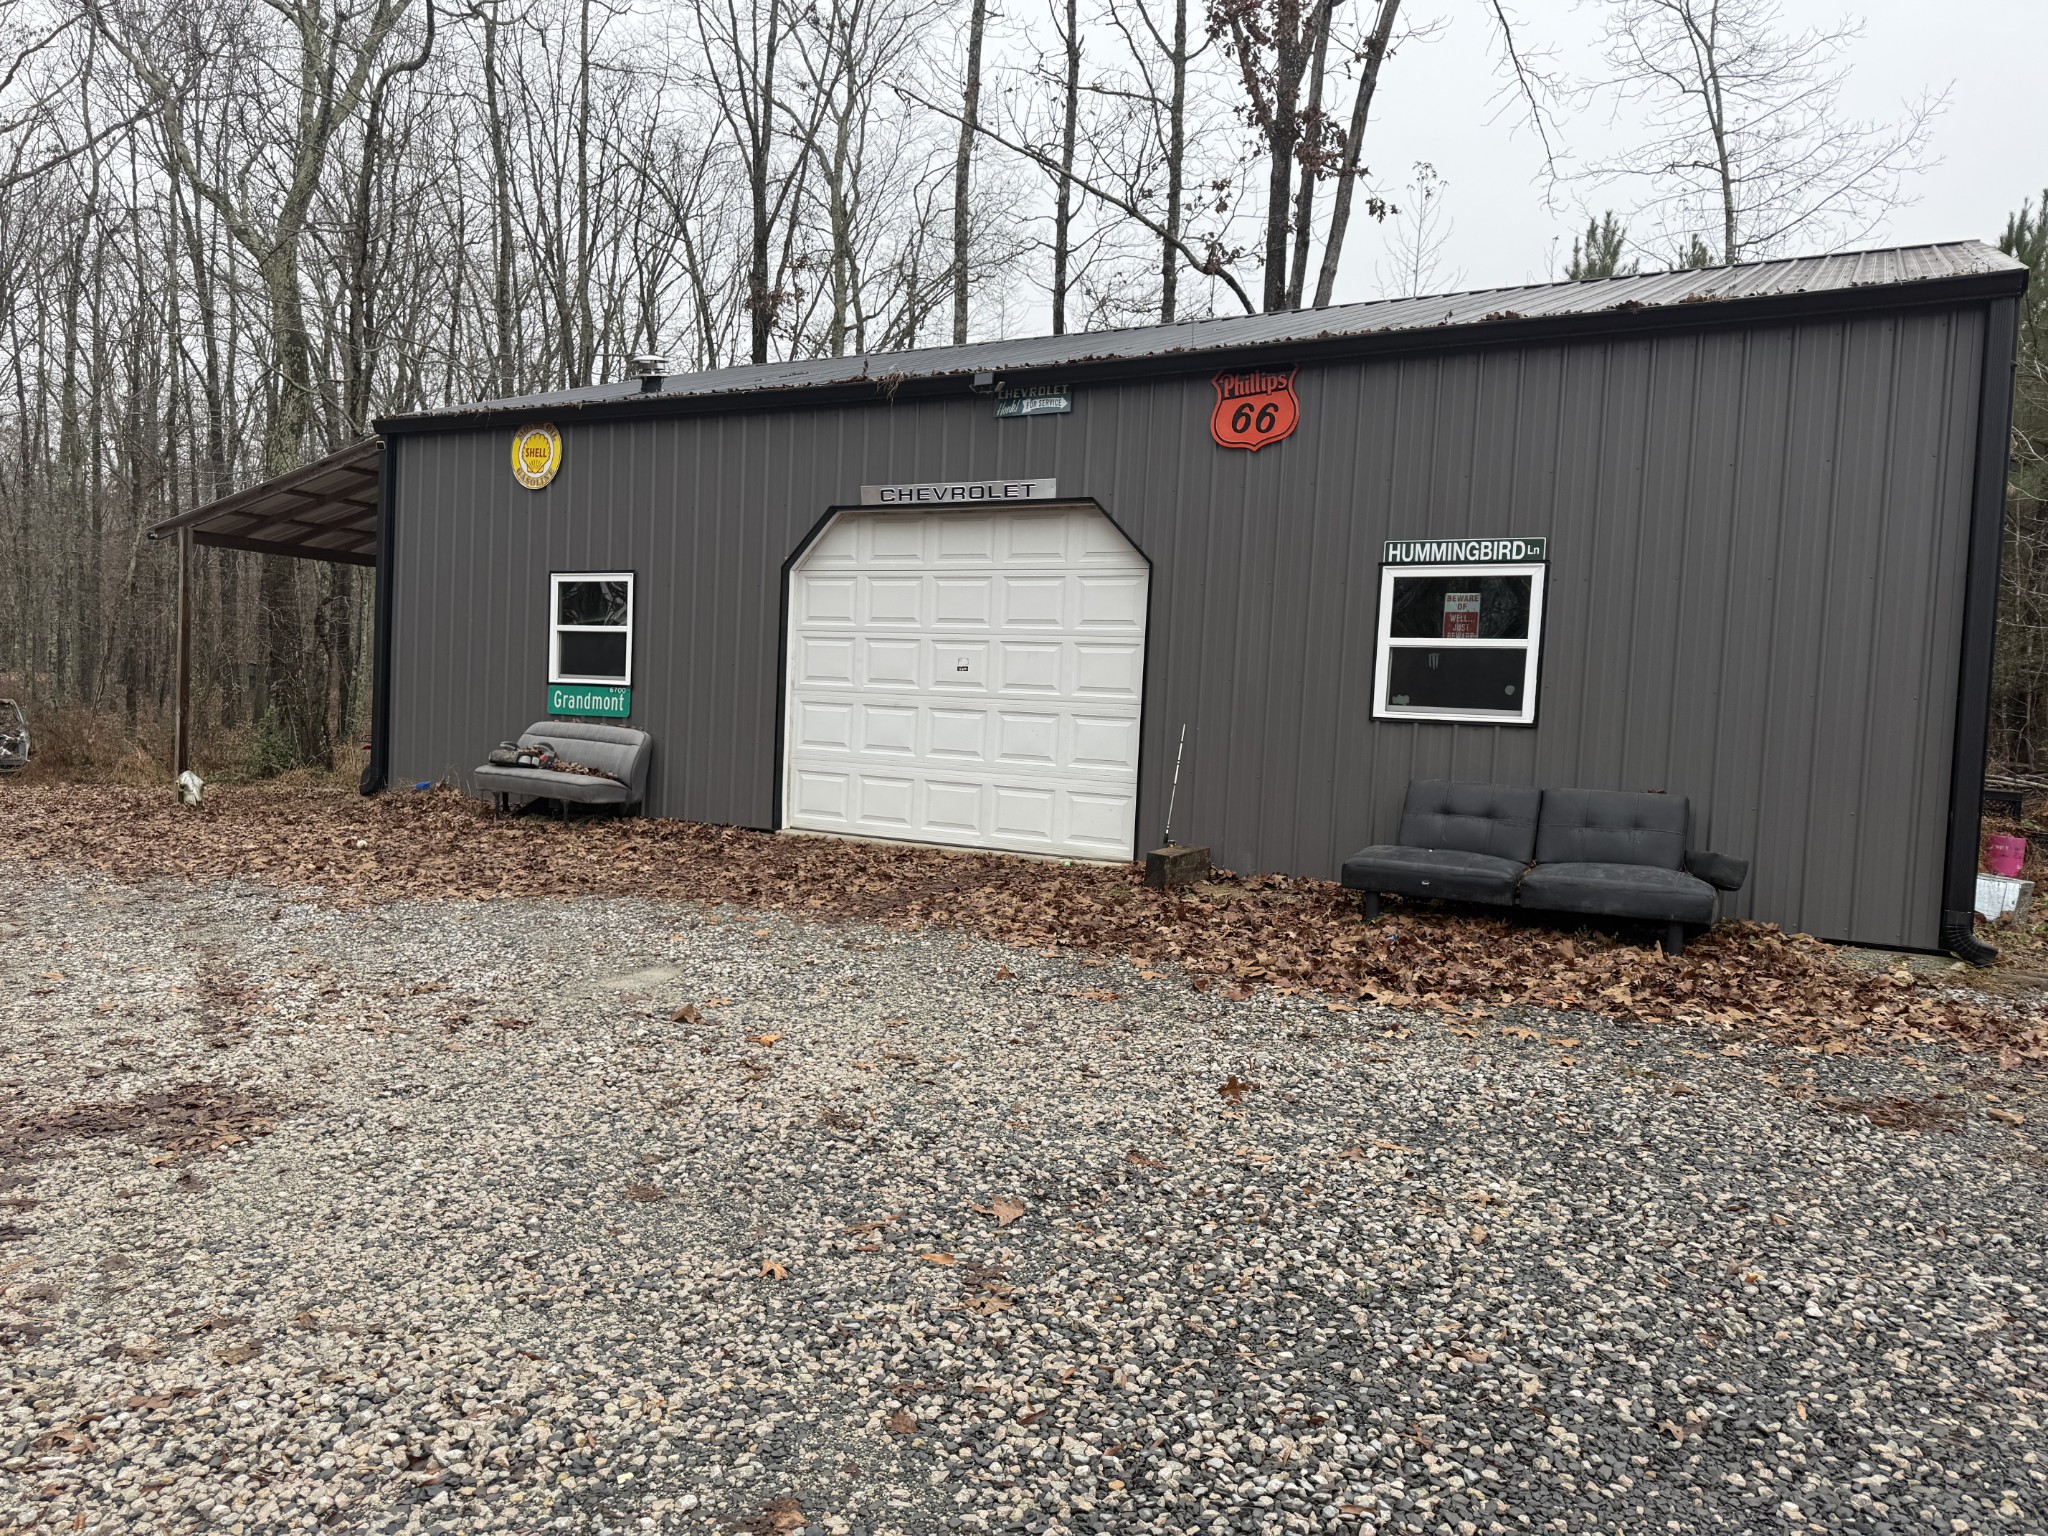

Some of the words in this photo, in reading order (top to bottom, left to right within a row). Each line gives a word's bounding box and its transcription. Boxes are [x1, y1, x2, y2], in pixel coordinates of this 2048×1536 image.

[998, 385, 1069, 400] CHEVROLET
[1218, 370, 1288, 398] Phillips
[1026, 401, 1038, 410] FOR
[1039, 399, 1062, 407] SERVICE
[1231, 403, 1279, 433] 66
[525, 448, 547, 458] SHELL
[516, 468, 555, 487] GASOLINE
[880, 483, 1036, 502] CHEVROLET
[1388, 541, 1526, 562] HUMMINGBIRD
[1527, 545, 1540, 555] Ln
[1446, 594, 1479, 602] BEWARE
[1452, 623, 1470, 632] JUST
[609, 686, 627, 694] 6700
[553, 690, 625, 711] Grandmont
